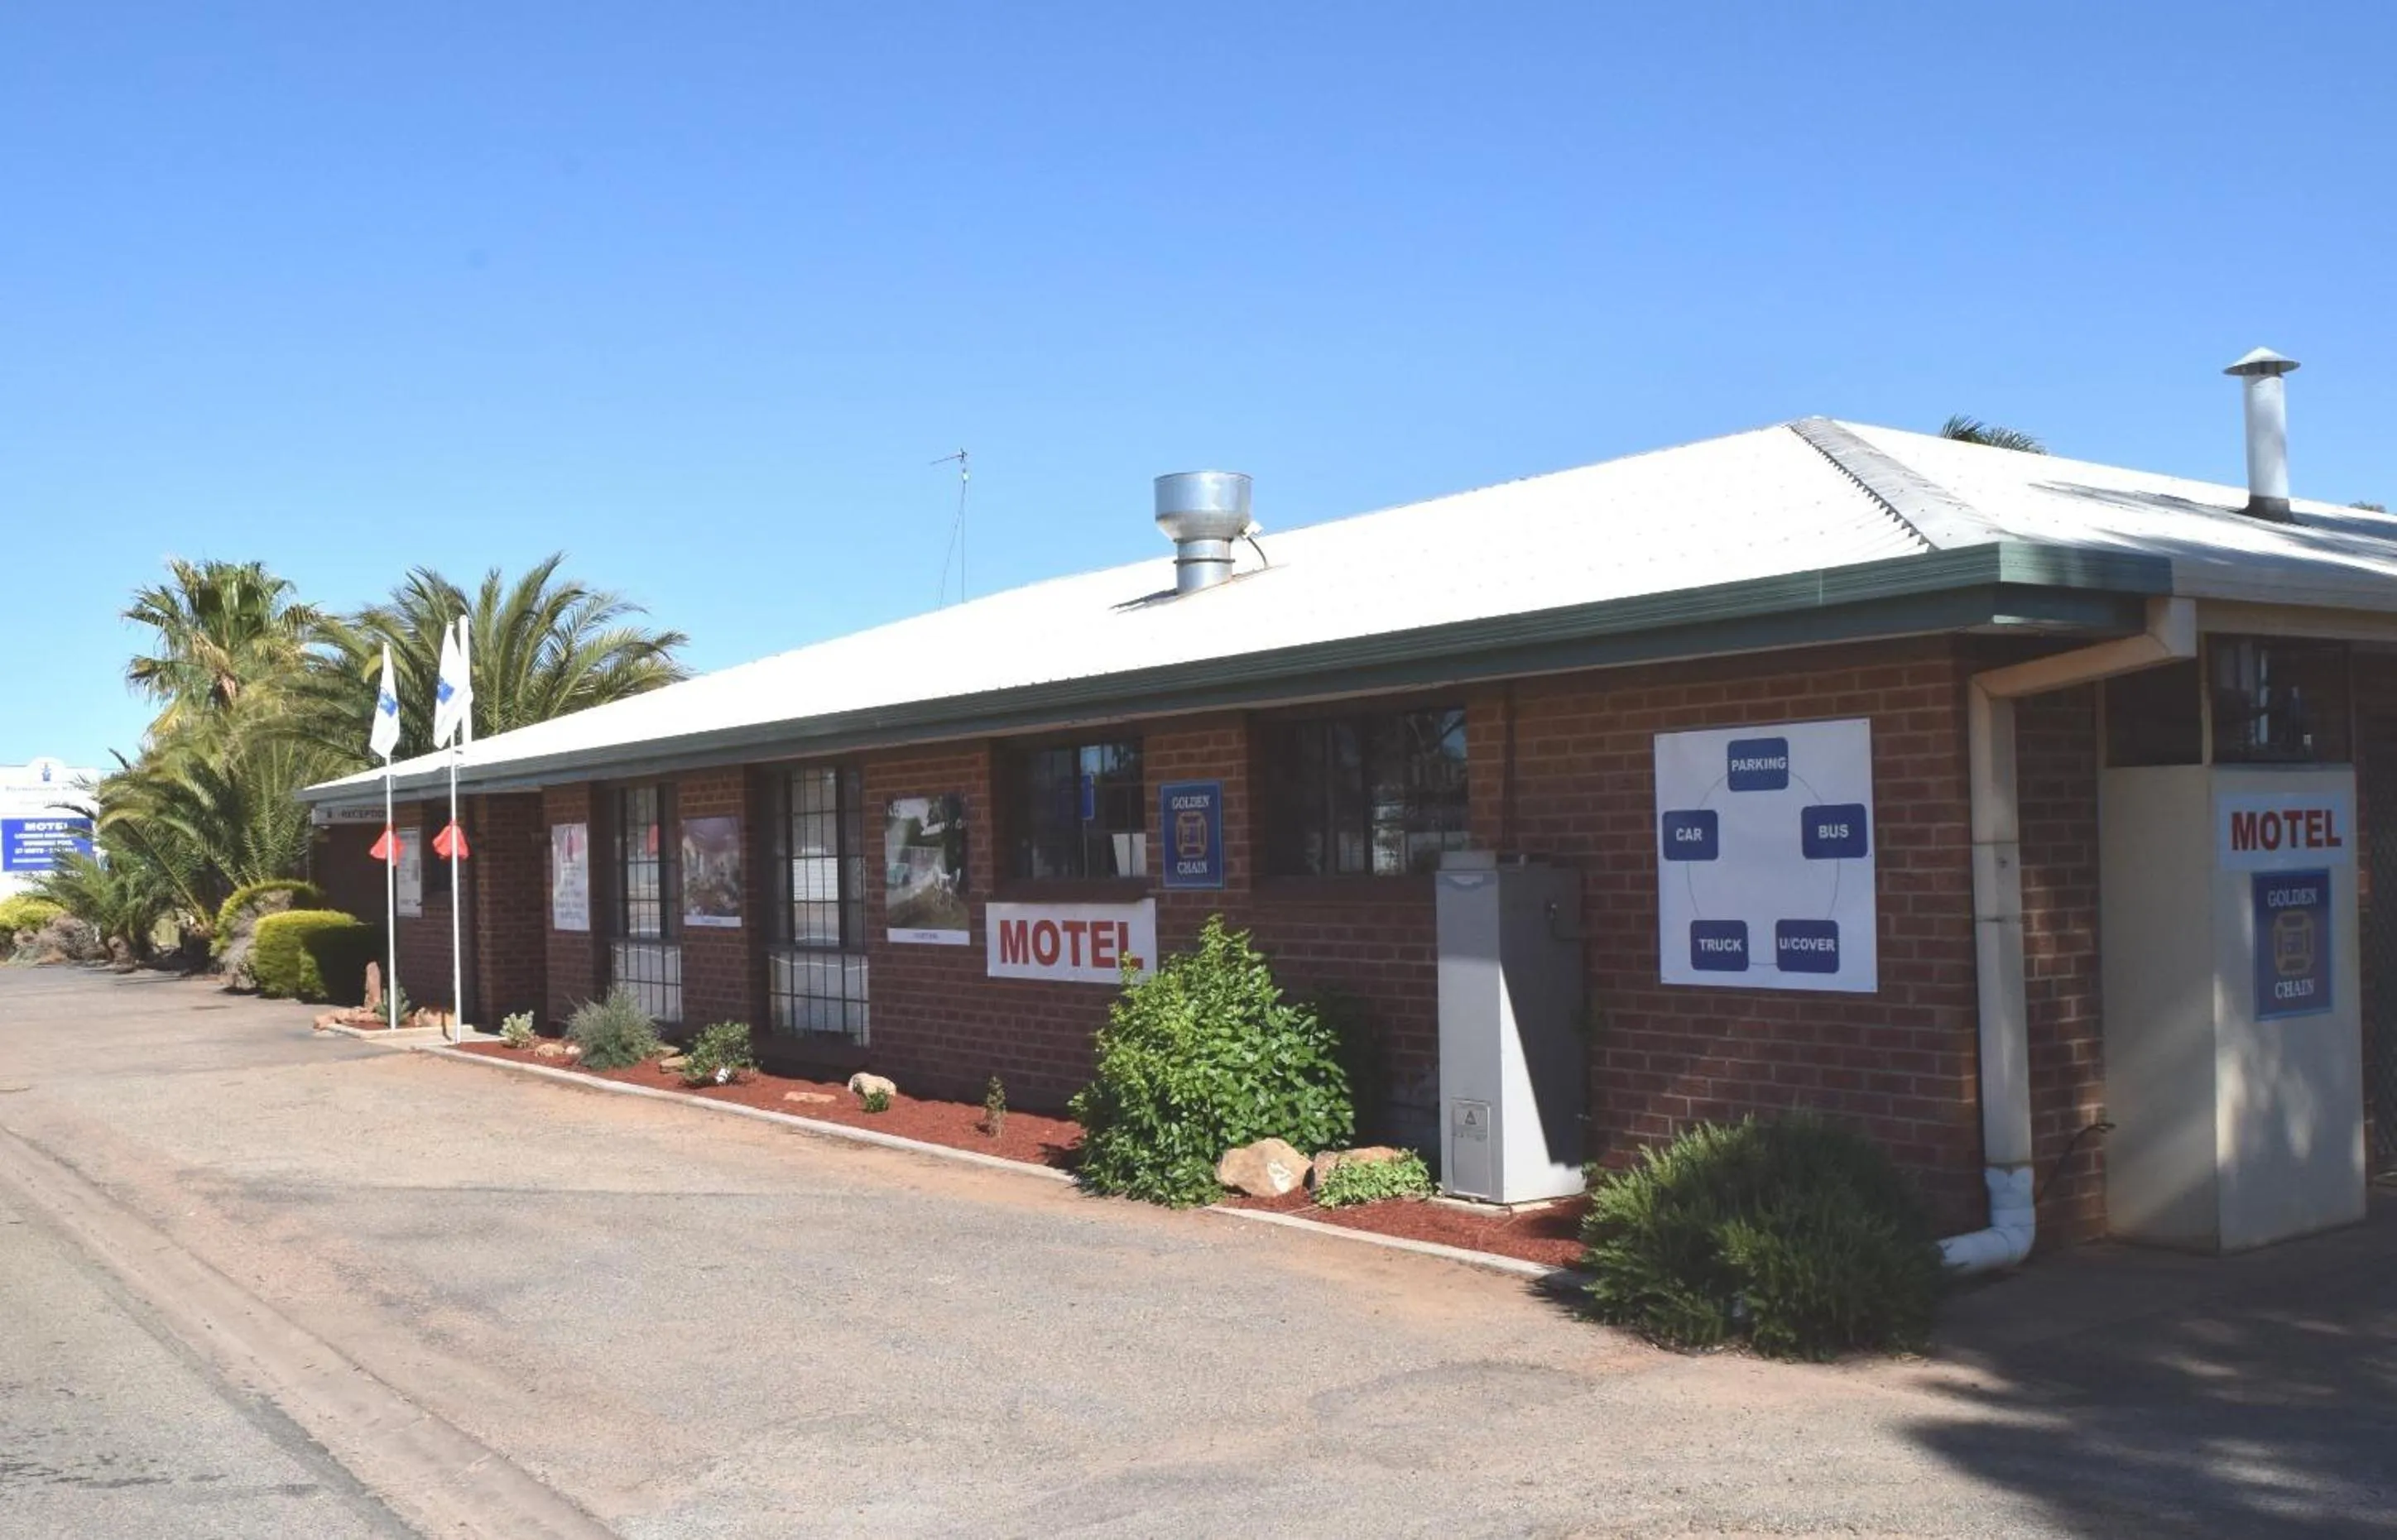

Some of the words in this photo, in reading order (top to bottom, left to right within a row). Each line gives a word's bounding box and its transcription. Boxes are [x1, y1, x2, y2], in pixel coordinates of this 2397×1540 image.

[1732, 757, 1786, 771] PARKING
[1172, 795, 1209, 809] GOLDEN
[341, 809, 387, 818] RECEPTIO
[1676, 828, 1702, 841] CAR
[1818, 824, 1849, 838] BUS
[2231, 809, 2342, 851] MOTEL
[1177, 860, 1208, 875] CHAIN
[2267, 888, 2318, 907] GOLDEN
[1000, 919, 1144, 969] MOTEL
[1698, 938, 1743, 952] TRUCK
[2275, 978, 2315, 999] CHAIN
